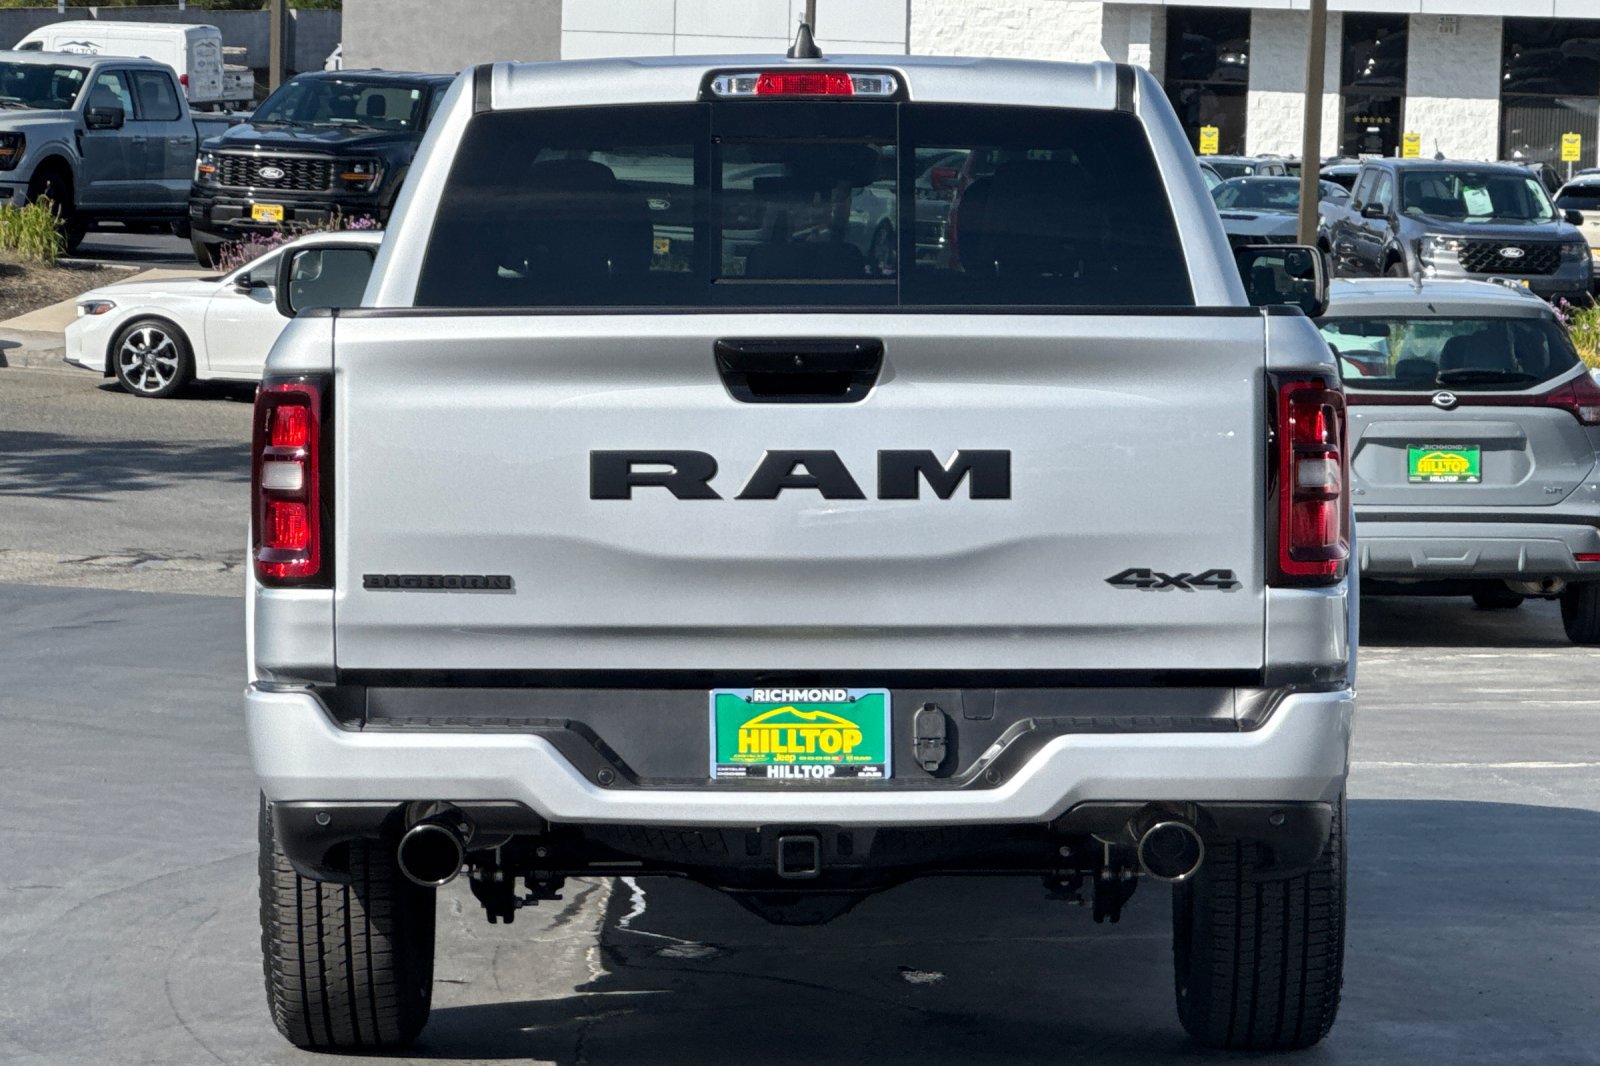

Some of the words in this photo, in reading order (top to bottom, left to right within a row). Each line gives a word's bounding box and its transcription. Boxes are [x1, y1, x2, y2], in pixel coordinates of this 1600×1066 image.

[1418, 461, 1469, 472] HILLTOP
[590, 450, 1011, 499] RAM
[1104, 568, 1239, 589] 4x4
[754, 689, 847, 702] RICHMOND
[738, 728, 863, 753] HILLTOP
[773, 753, 796, 763] Jeep
[767, 765, 835, 778] HILLTOP
